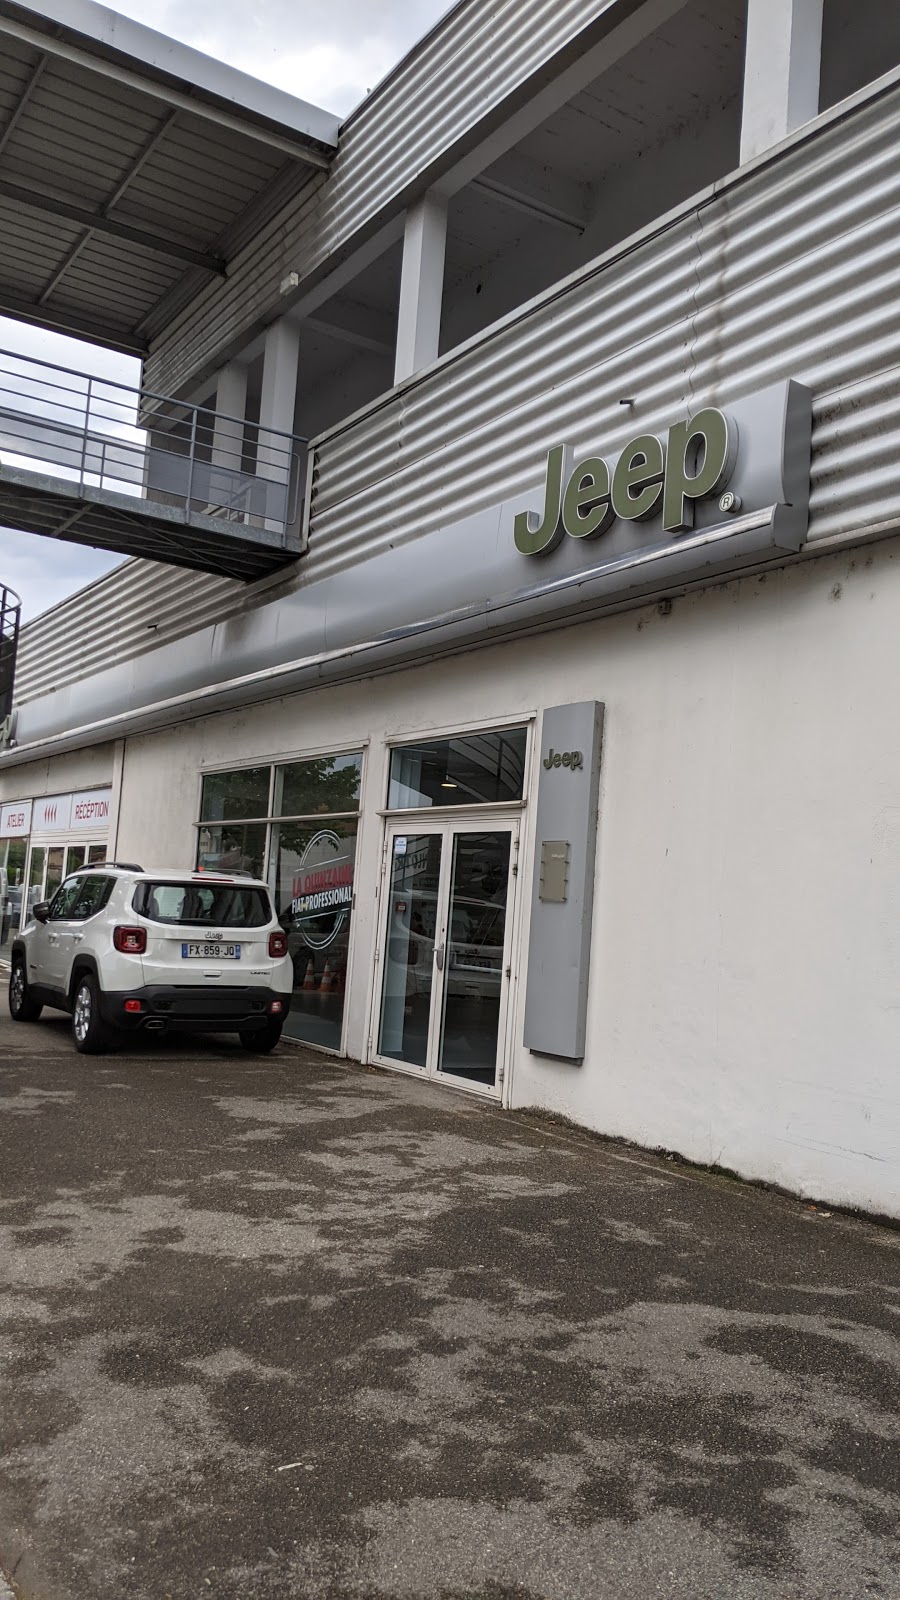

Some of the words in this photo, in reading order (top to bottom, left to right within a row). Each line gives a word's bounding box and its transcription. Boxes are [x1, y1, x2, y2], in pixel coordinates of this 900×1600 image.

[513, 406, 730, 557] Jeep
[543, 748, 584, 771] Jeep
[7, 813, 25, 828] ATELIER
[75, 800, 110, 820] RÉCÉPTION
[292, 877, 302, 898] LA
